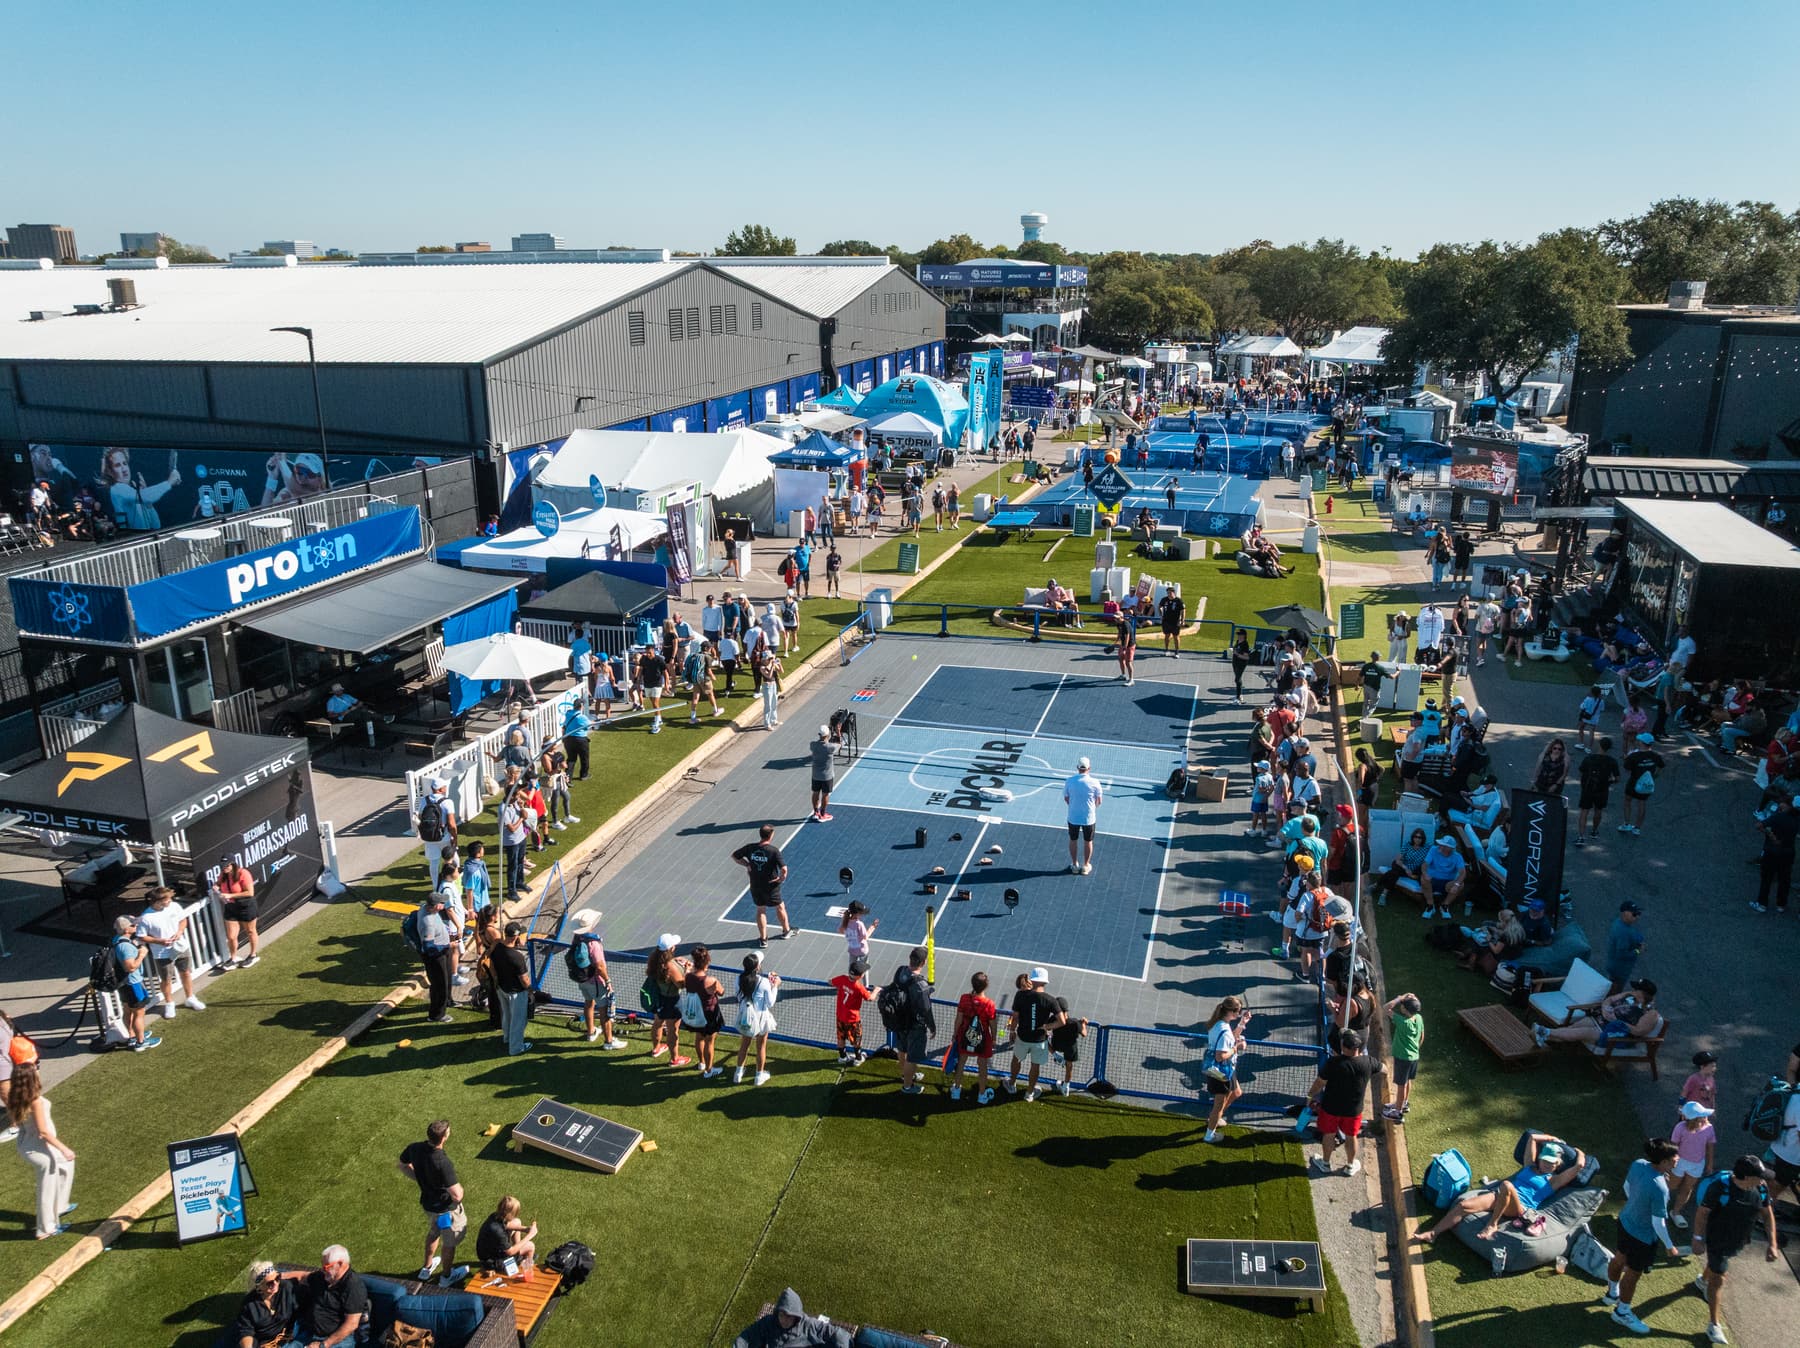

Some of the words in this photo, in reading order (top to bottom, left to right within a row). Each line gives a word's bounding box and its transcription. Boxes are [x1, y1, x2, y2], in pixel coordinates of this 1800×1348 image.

[208, 468, 247, 477] CARVANA
[925, 791, 948, 806] THE
[945, 740, 1027, 812] PICKLR
[171, 752, 295, 827] PADDLETEK
[1, 807, 128, 836] ADDLETEK
[242, 822, 267, 844] BECOME
[245, 813, 309, 868] AMBASSADOR
[842, 991, 850, 1005] 7
[180, 1175, 207, 1184] Where
[180, 1184, 203, 1192] Texas
[205, 1180, 227, 1188] Plays
[180, 1188, 219, 1200] Pickleball
